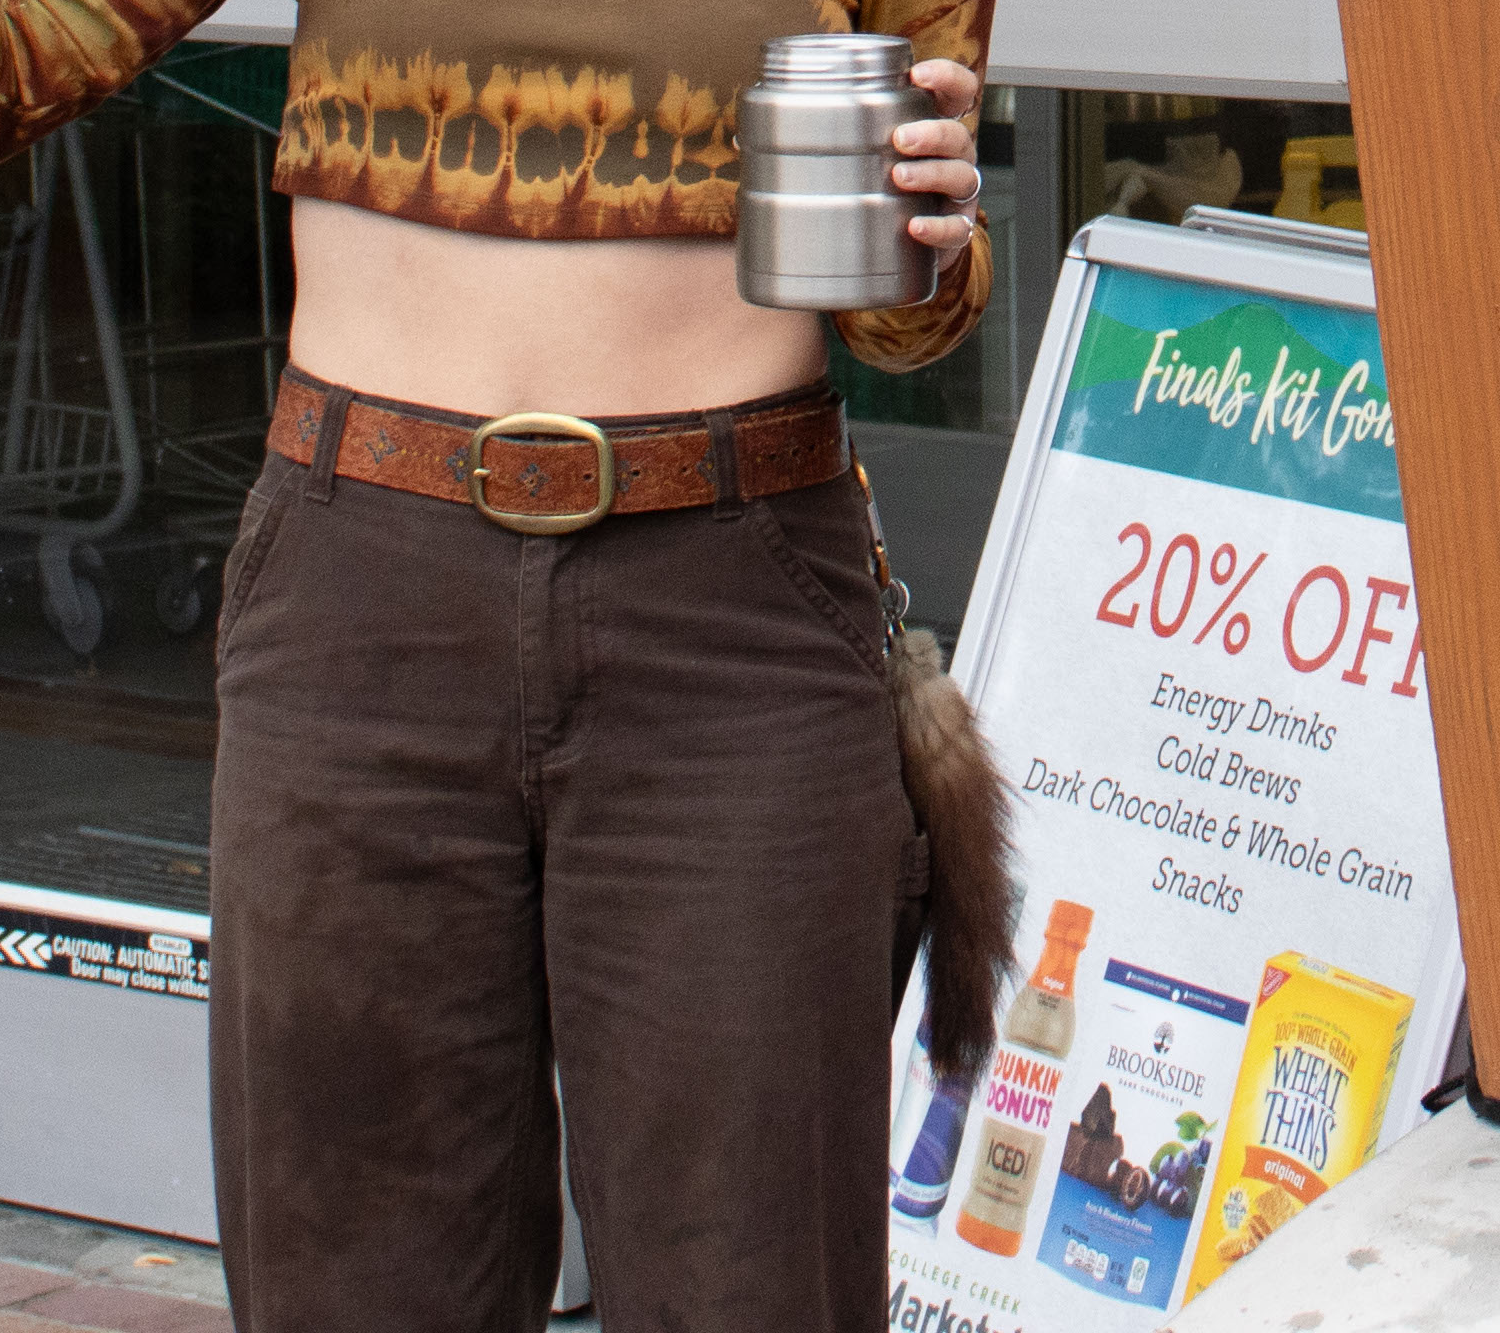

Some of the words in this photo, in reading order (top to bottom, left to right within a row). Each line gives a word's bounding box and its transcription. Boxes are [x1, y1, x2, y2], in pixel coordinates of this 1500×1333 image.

[1134, 329, 1255, 428] Finals
[1251, 346, 1321, 444] Kit
[1096, 522, 1268, 655] 20%
[1151, 672, 1245, 734] Energy
[1247, 697, 1338, 752] Drinks
[1156, 735, 1214, 782] Cold
[1219, 751, 1301, 805] Brews
[1022, 757, 1085, 805] Dark
[1089, 775, 1217, 847] Chocolate
[1221, 815, 1242, 849] &
[1244, 820, 1333, 878] Whole
[1336, 847, 1414, 902] Grain
[1151, 856, 1244, 915] Snacks
[71, 956, 101, 980] Door
[102, 966, 129, 988] may
[130, 970, 167, 991] close
[117, 946, 197, 978] AUTOMATIC
[1106, 1045, 1206, 1098] BROOKSIDE
[1273, 1045, 1350, 1115] WHEAT
[1297, 1024, 1327, 1053] WHOLE
[1329, 1036, 1357, 1074] GRAIN
[986, 1080, 1052, 1128] DONUTS
[1264, 1158, 1307, 1191] original
[889, 1249, 961, 1290] COLLEGE
[970, 1281, 1021, 1315] CREEK
